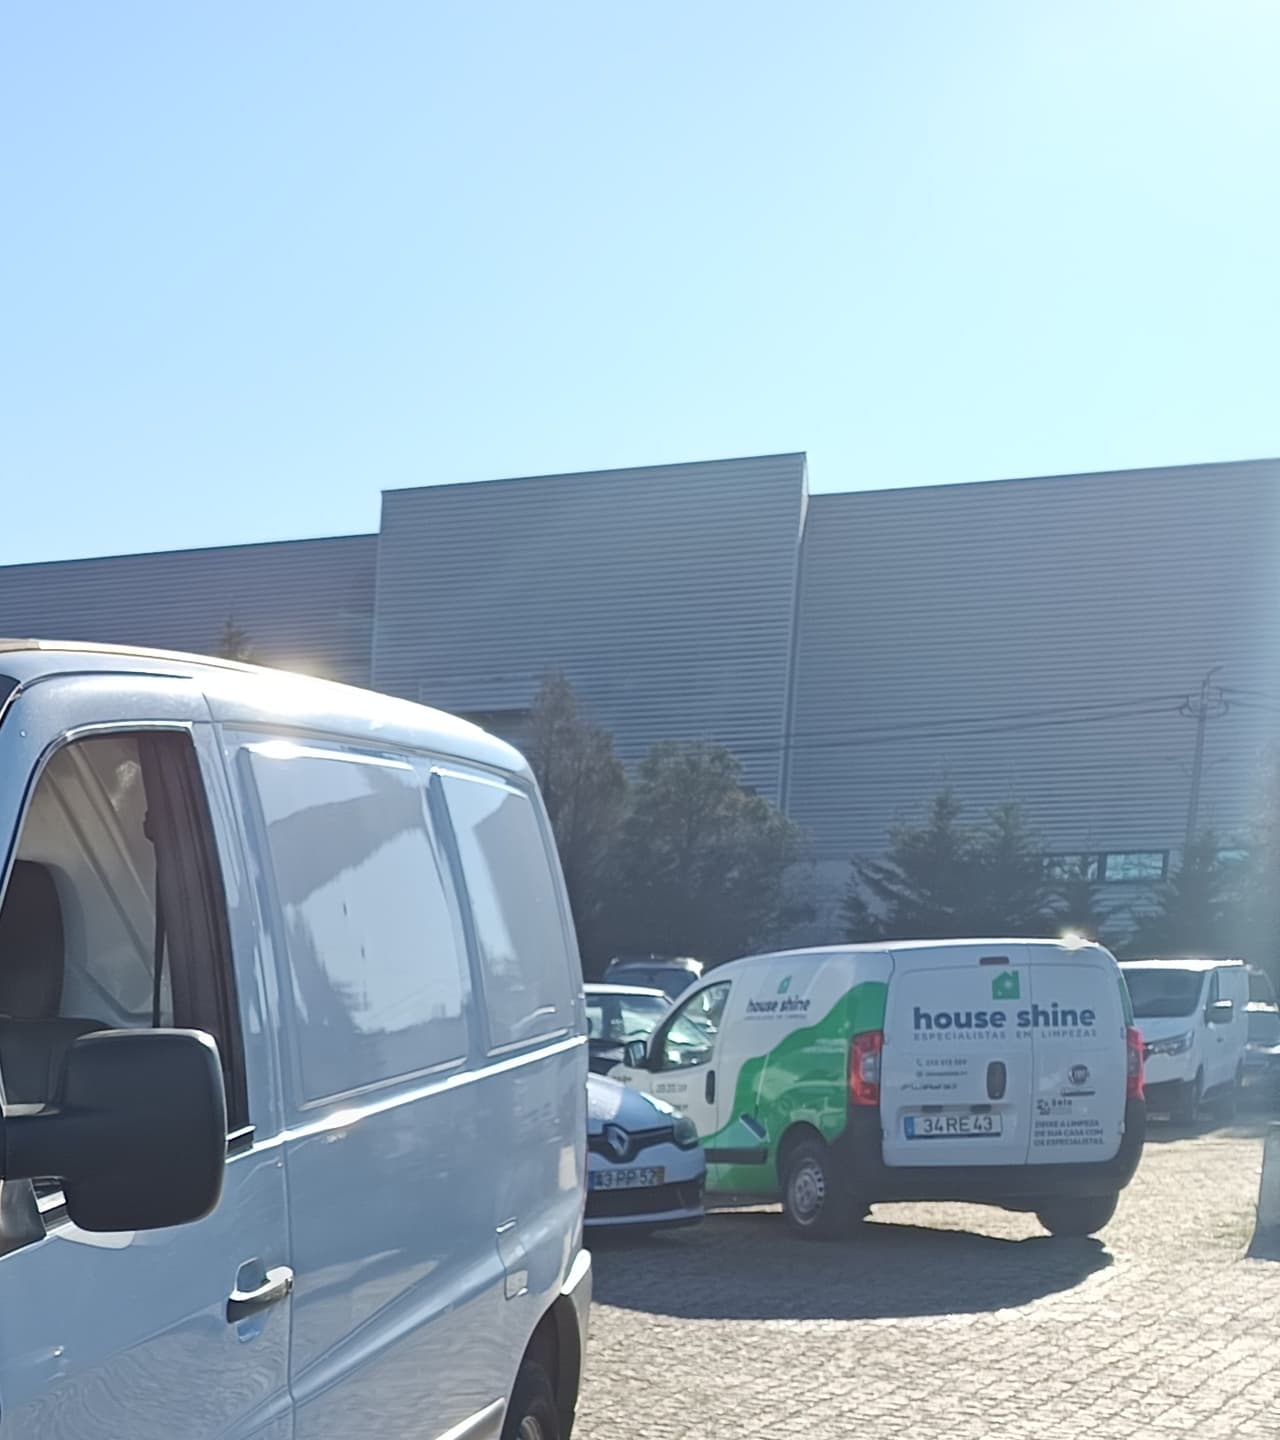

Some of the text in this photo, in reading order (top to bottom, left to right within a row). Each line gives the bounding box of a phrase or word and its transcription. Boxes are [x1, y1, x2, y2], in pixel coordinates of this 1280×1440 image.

[913, 1002, 1096, 1030] house shine
[914, 1031, 1006, 1041] ESPECIALISTAS
